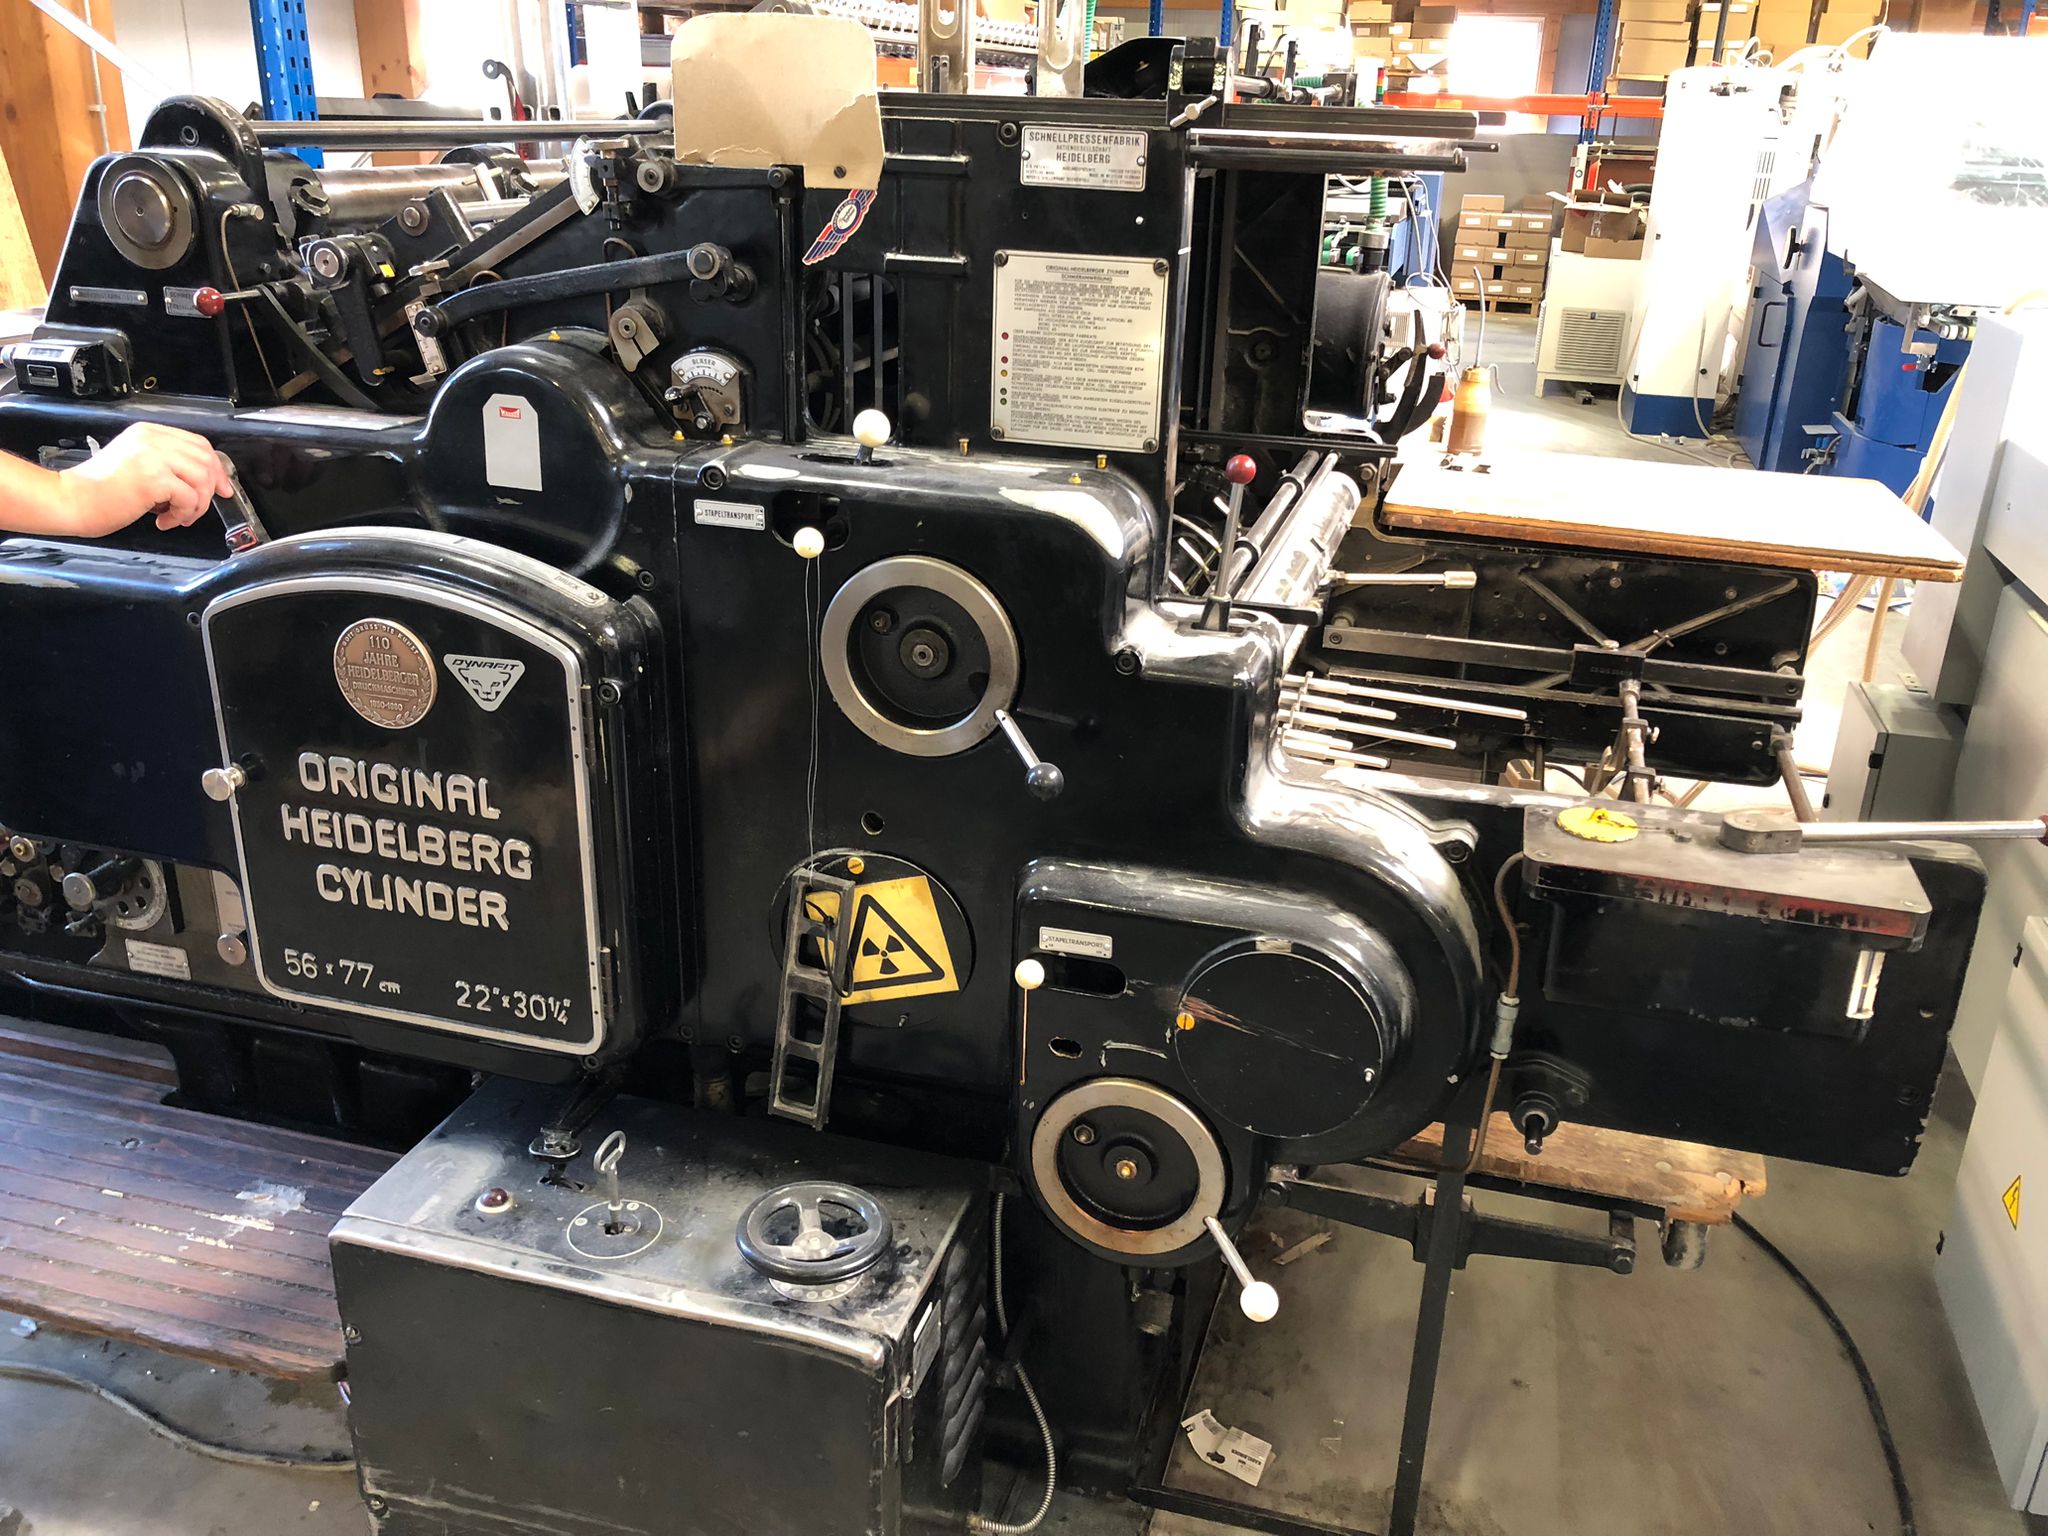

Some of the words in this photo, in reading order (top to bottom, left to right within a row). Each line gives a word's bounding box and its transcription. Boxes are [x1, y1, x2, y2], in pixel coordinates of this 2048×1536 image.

[1029, 131, 1140, 146] SCHNELLPRESSENFABRIK
[1056, 153, 1111, 164] HEIDELBERG
[704, 509, 755, 521] STAPELTRANSPORT
[369, 635, 390, 650] 110
[363, 651, 399, 668] JAHRE
[452, 658, 520, 671] DYNAFIT
[347, 665, 420, 686] HEIDELBERGER
[352, 681, 418, 697] DRUCKMASCHINEN
[298, 752, 501, 820] ORIGINAL
[281, 803, 532, 880] HEIDELBERG
[316, 863, 510, 932] CYLINDER
[1048, 936, 1103, 949] STAPELTRANSPORT
[379, 980, 401, 994] cm
